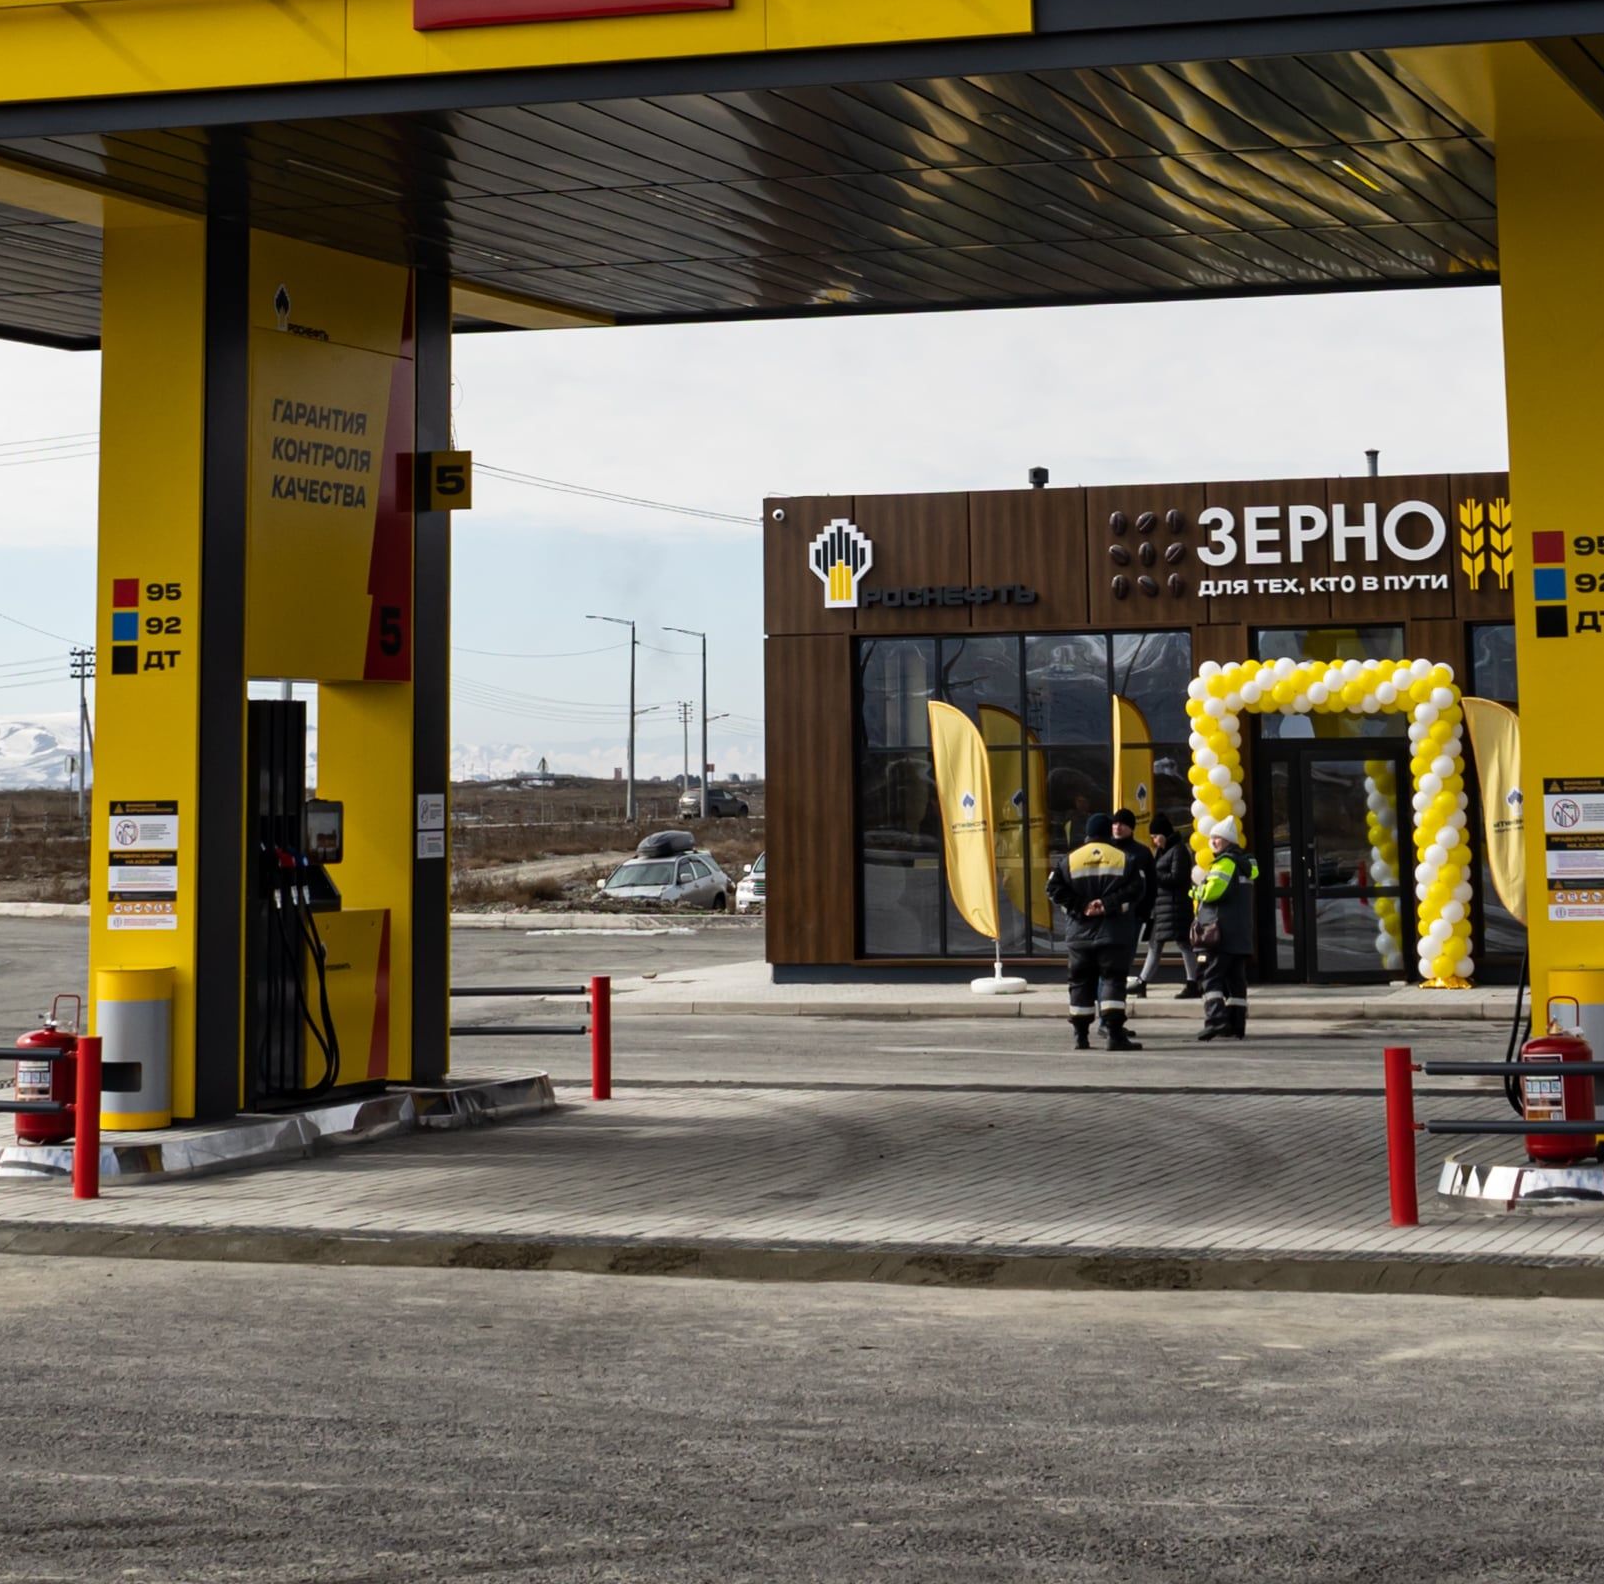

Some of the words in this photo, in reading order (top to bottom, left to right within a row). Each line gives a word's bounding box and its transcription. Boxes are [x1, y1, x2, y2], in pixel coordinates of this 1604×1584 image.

[271, 398, 368, 436] ГАРАНТИЯ
[271, 436, 372, 473] КОНТРОЛЯ
[271, 474, 367, 509] КАЧЕСТВА
[435, 465, 465, 496] 5
[1196, 499, 1447, 567] ЗЕРНО
[145, 582, 183, 602] 95
[862, 584, 1038, 609] РОСНЕФТЬ
[1197, 579, 1249, 598] ДЛЯ
[1253, 577, 1306, 596] ТЕХ,
[1309, 574, 1357, 594] КТО
[1361, 575, 1380, 592] В
[1383, 573, 1449, 592] ПУТИ
[145, 616, 182, 635] 92
[379, 605, 402, 657] 5
[143, 649, 182, 672] ДТ
